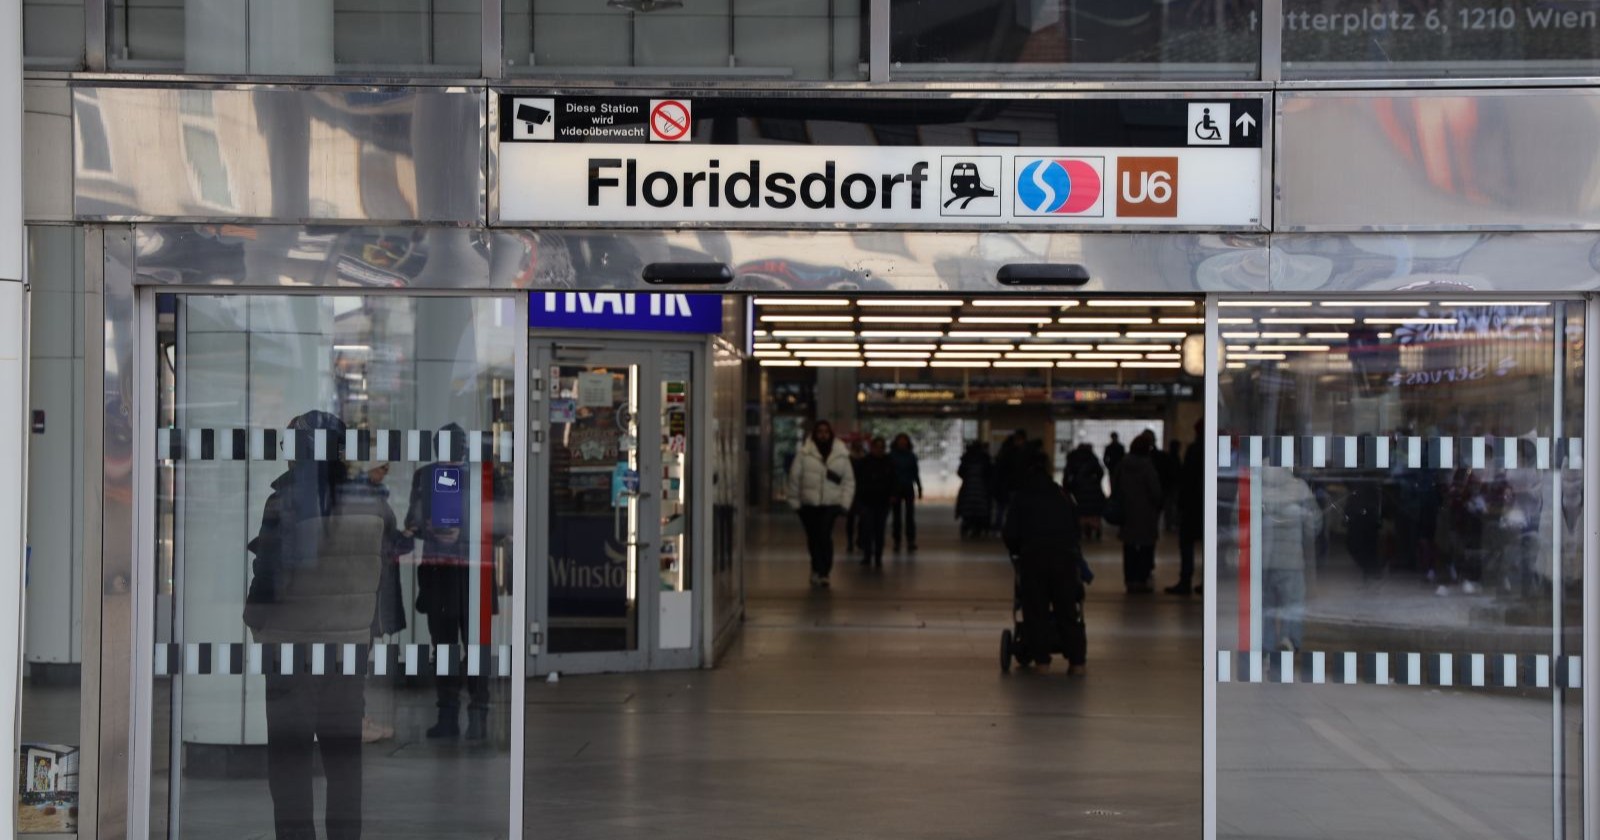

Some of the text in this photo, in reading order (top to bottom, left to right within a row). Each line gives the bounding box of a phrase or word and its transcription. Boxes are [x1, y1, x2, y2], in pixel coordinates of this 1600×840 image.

[1250, 7, 1596, 35] Htterplatz 6, 1210 Wien
[566, 103, 639, 114] Diese Station
[591, 115, 614, 125] wird
[560, 126, 645, 137] videoüberwacht
[587, 158, 929, 210] Floridsdorf
[1122, 170, 1173, 204] U6
[547, 554, 628, 590] Winsto
